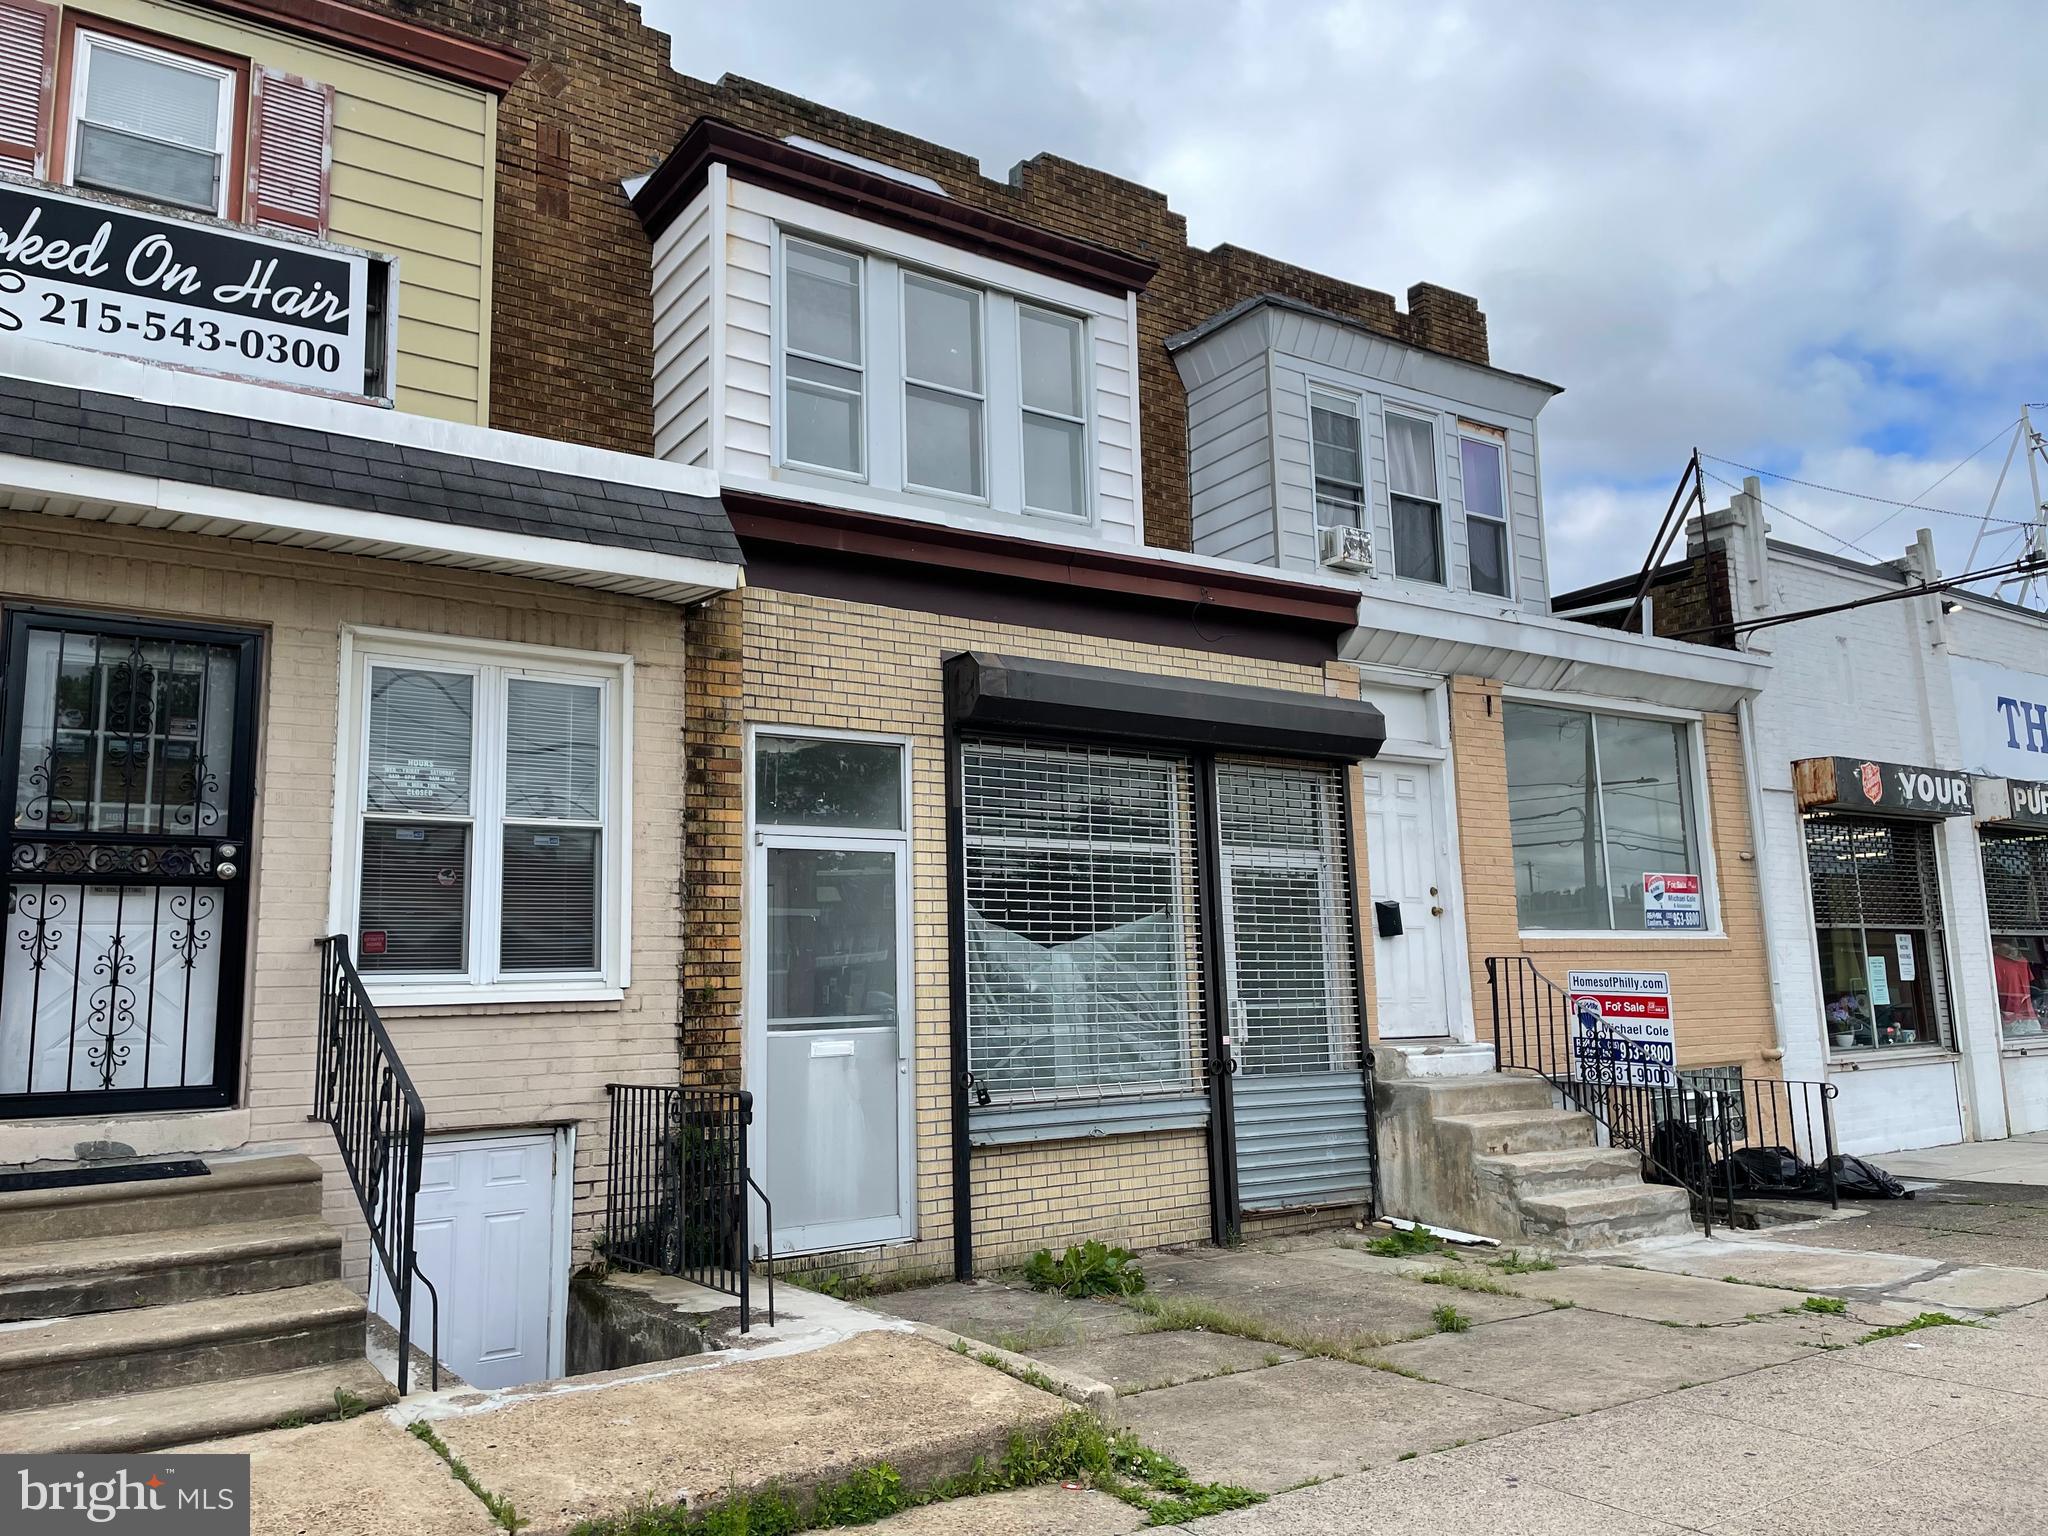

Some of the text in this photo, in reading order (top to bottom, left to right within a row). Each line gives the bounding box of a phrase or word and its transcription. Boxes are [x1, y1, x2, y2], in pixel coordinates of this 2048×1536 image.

[125, 233, 201, 295] On
[213, 258, 349, 324] Hair
[40, 292, 340, 373] 215-543-0300
[1997, 696, 2048, 753] TH
[1898, 772, 1969, 806] YOUR
[1572, 975, 1664, 991] HomesofPhilly.com
[1605, 1001, 1621, 1012] For
[1623, 1002, 1645, 1012] Sale
[1645, 1024, 1669, 1036] Cole
